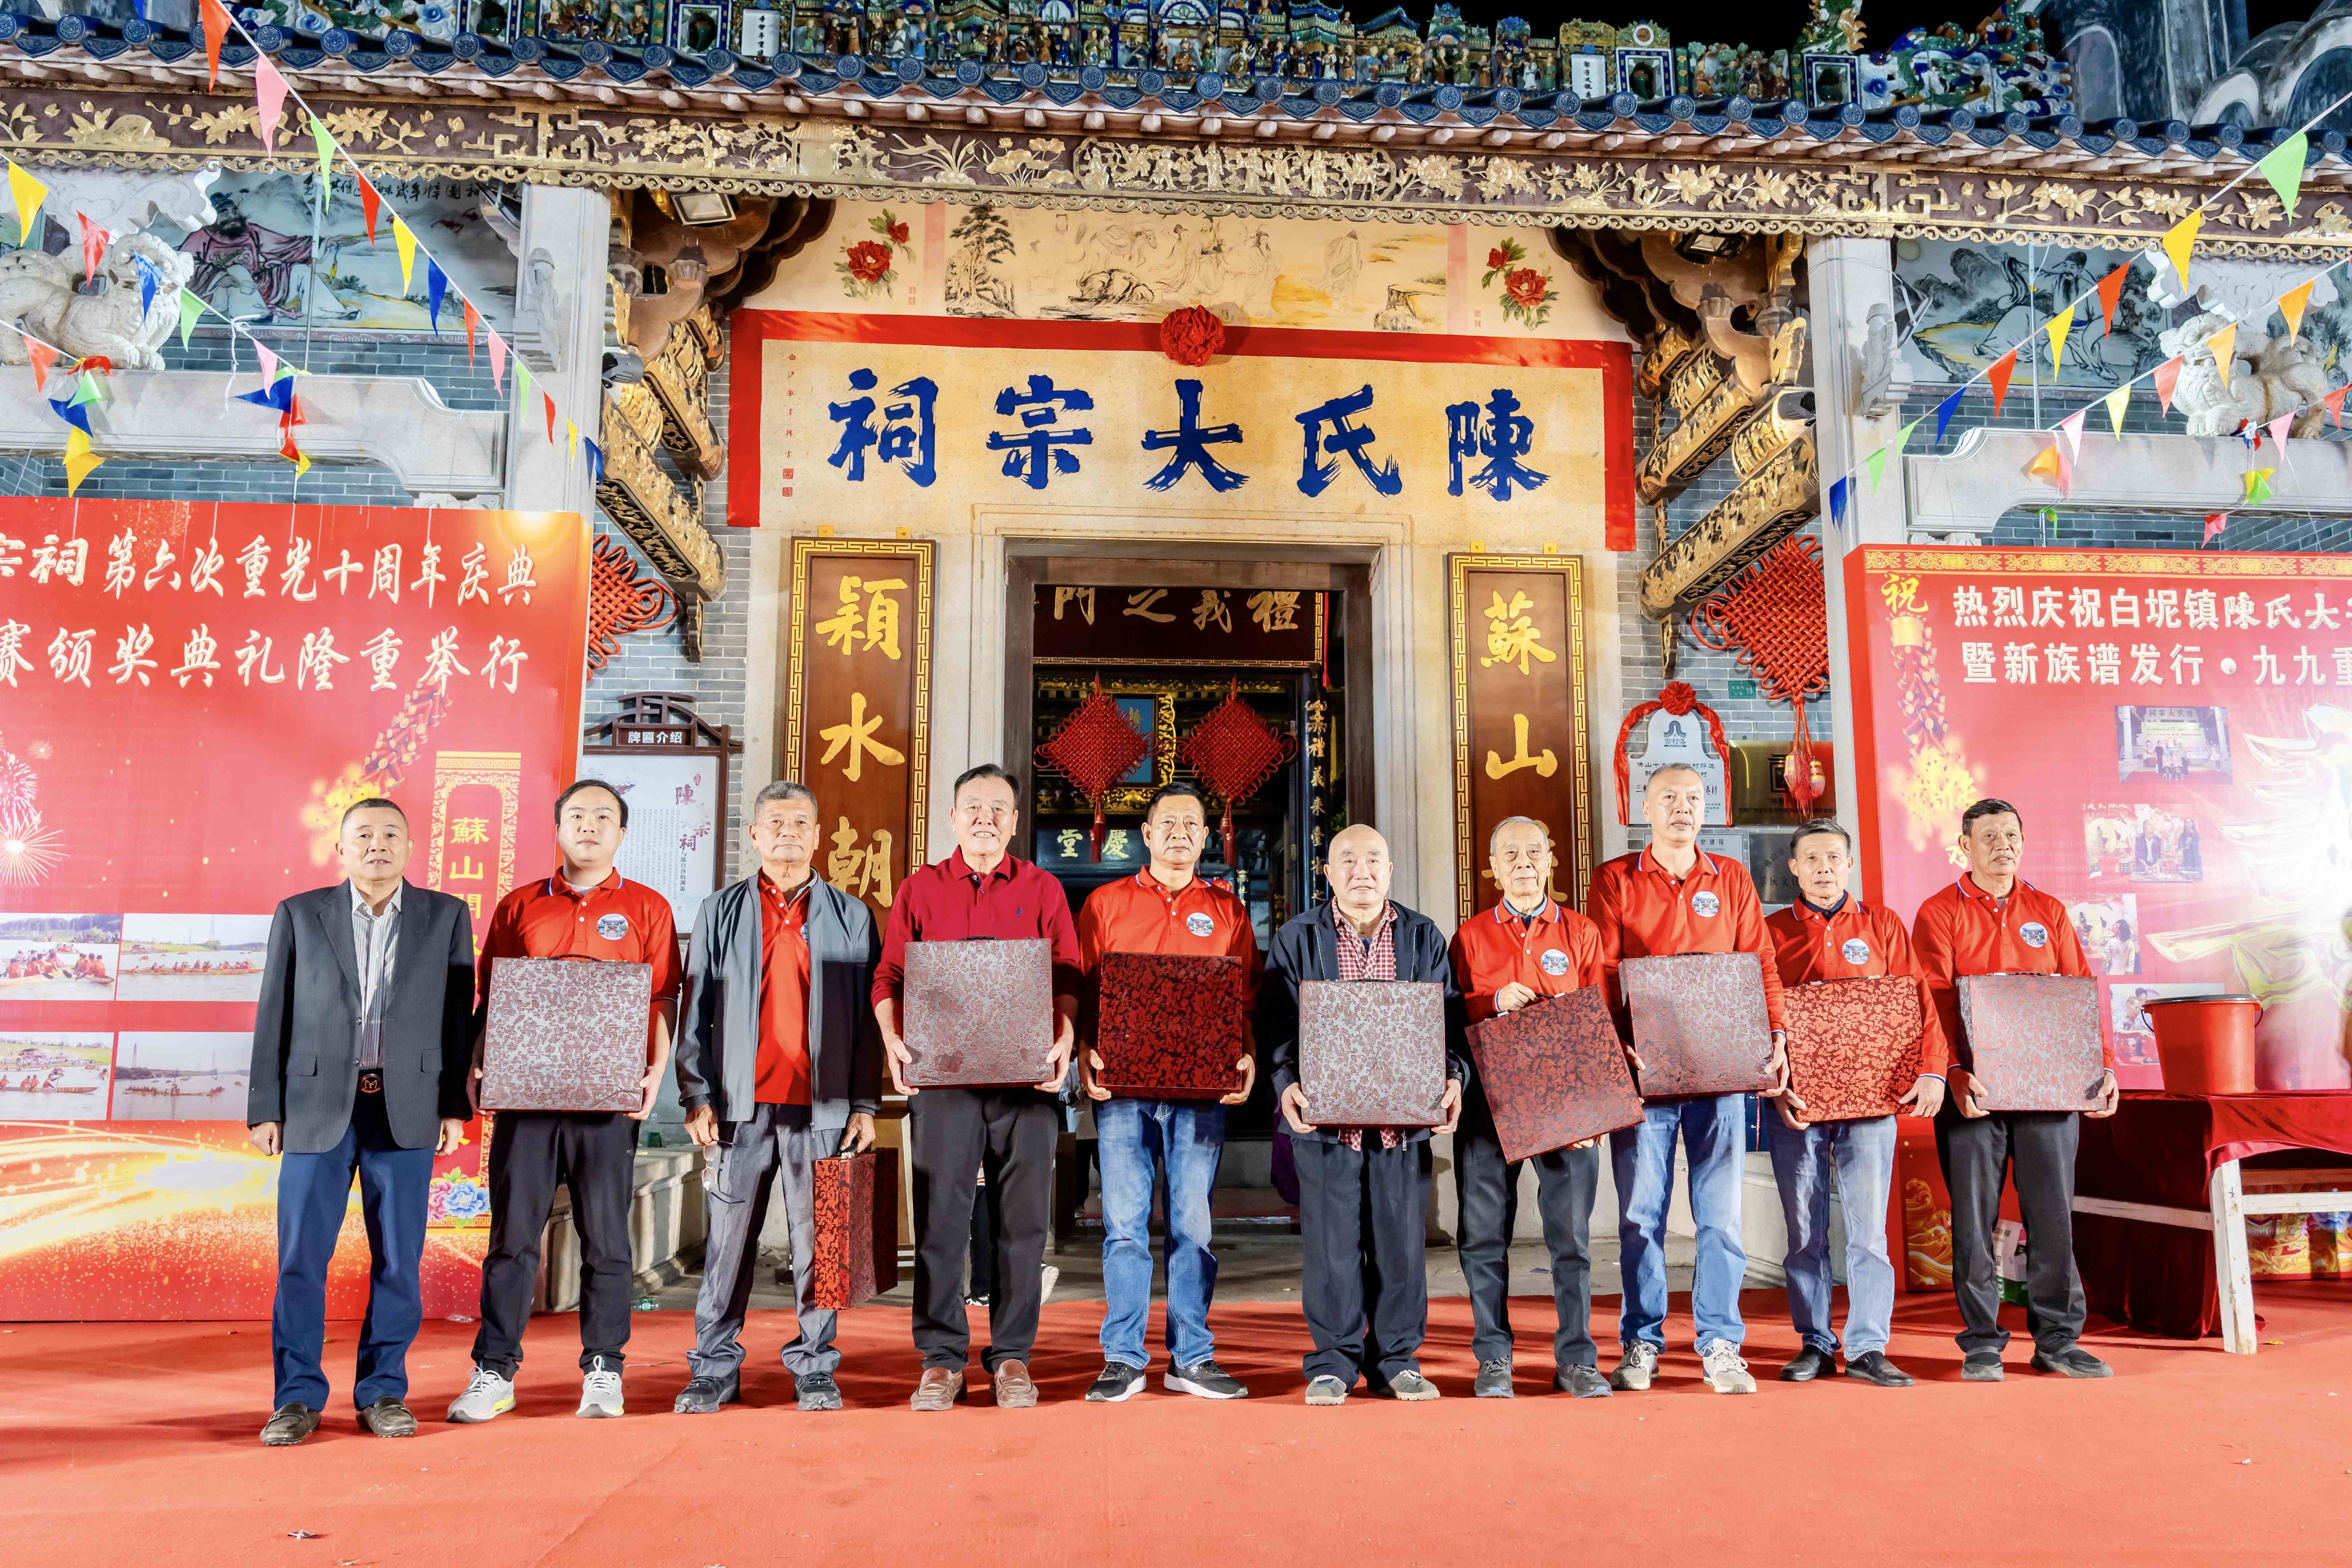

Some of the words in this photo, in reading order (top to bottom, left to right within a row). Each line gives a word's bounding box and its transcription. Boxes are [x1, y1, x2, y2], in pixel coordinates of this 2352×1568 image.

[827, 368, 1551, 502] 陳氏大宗祠
[1881, 573, 1928, 614] 祝
[1953, 585, 2352, 631] 热烈庆祝白坭镇陳氏大
[0, 618, 528, 694] 赛颁奖典礼隆重举行
[628, 731, 682, 744] 牌匾介绍
[1479, 590, 1568, 901] 蘇山
